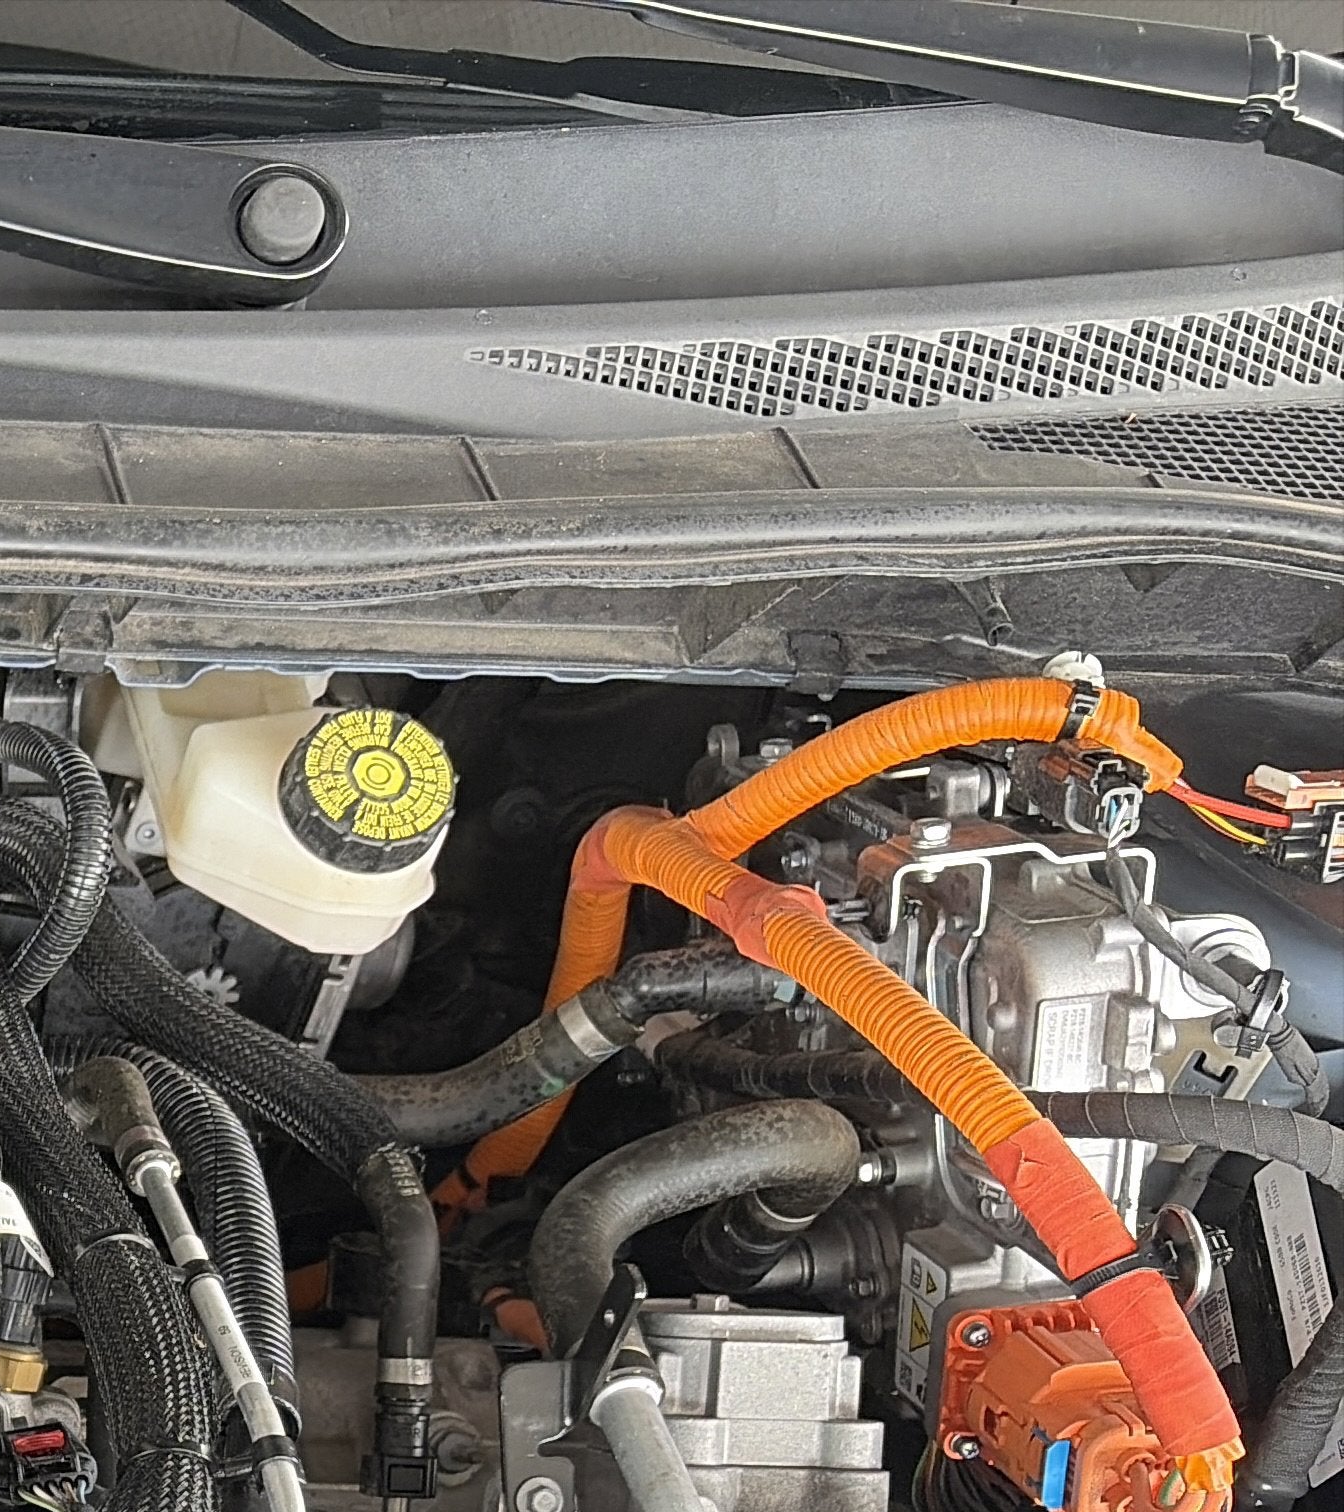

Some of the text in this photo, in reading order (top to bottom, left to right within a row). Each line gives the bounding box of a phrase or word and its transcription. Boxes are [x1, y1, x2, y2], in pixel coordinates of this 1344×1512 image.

[337, 709, 364, 729] FLUID
[373, 711, 392, 724] DOT
[316, 719, 341, 742] FROM
[338, 720, 371, 742] BEFORE
[373, 723, 391, 735] CAP
[303, 746, 324, 775] SEALED
[331, 745, 353, 771] CLEAN
[320, 773, 335, 790] USE
[308, 778, 344, 823] CONTAINER
[326, 788, 350, 811] ONLY
[433, 791, 450, 804] LE
[361, 812, 377, 826] DOT
[380, 812, 403, 828] FREIN
[411, 801, 445, 831] BOUCHON
[387, 821, 416, 840] AVANT
